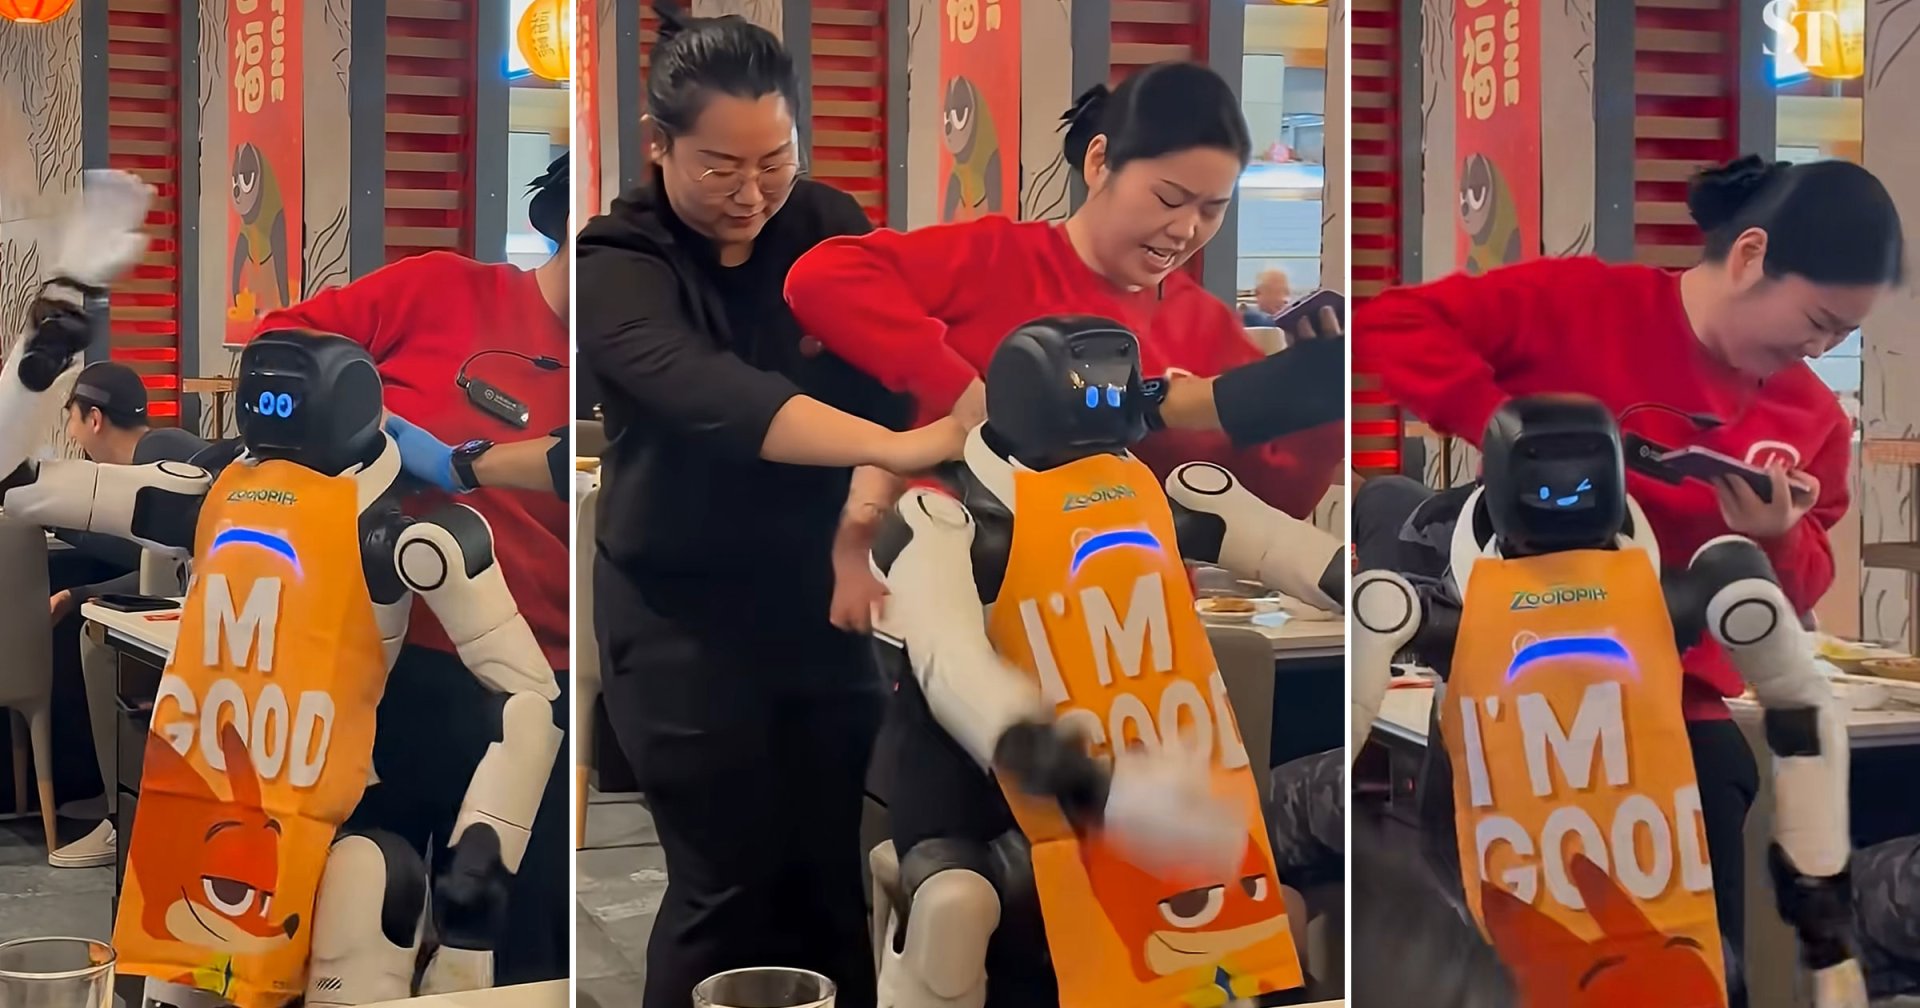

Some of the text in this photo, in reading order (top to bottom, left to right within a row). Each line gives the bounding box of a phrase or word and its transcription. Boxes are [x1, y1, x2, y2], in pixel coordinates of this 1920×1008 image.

[1018, 571, 1173, 707] I'M
[150, 674, 335, 788] GOOD
[1459, 680, 1630, 807] I'M
